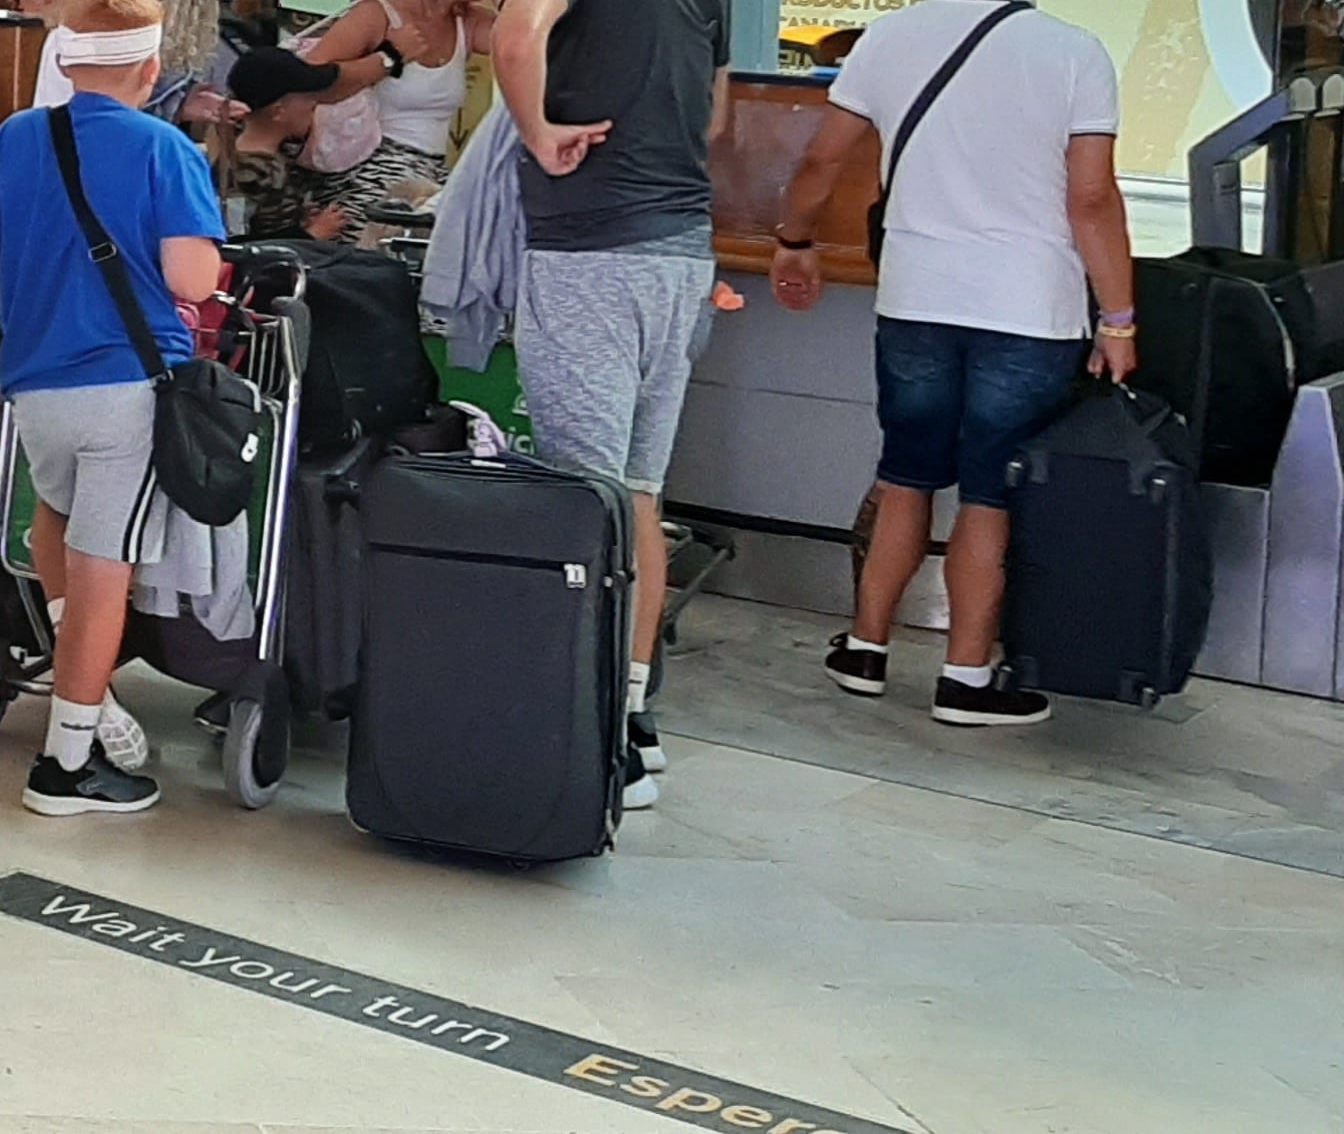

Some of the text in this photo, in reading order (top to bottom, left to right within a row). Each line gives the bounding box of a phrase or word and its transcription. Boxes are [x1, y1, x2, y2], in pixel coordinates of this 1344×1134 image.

[39, 892, 186, 955] Wait
[191, 943, 351, 1006] your
[363, 994, 514, 1053] turn
